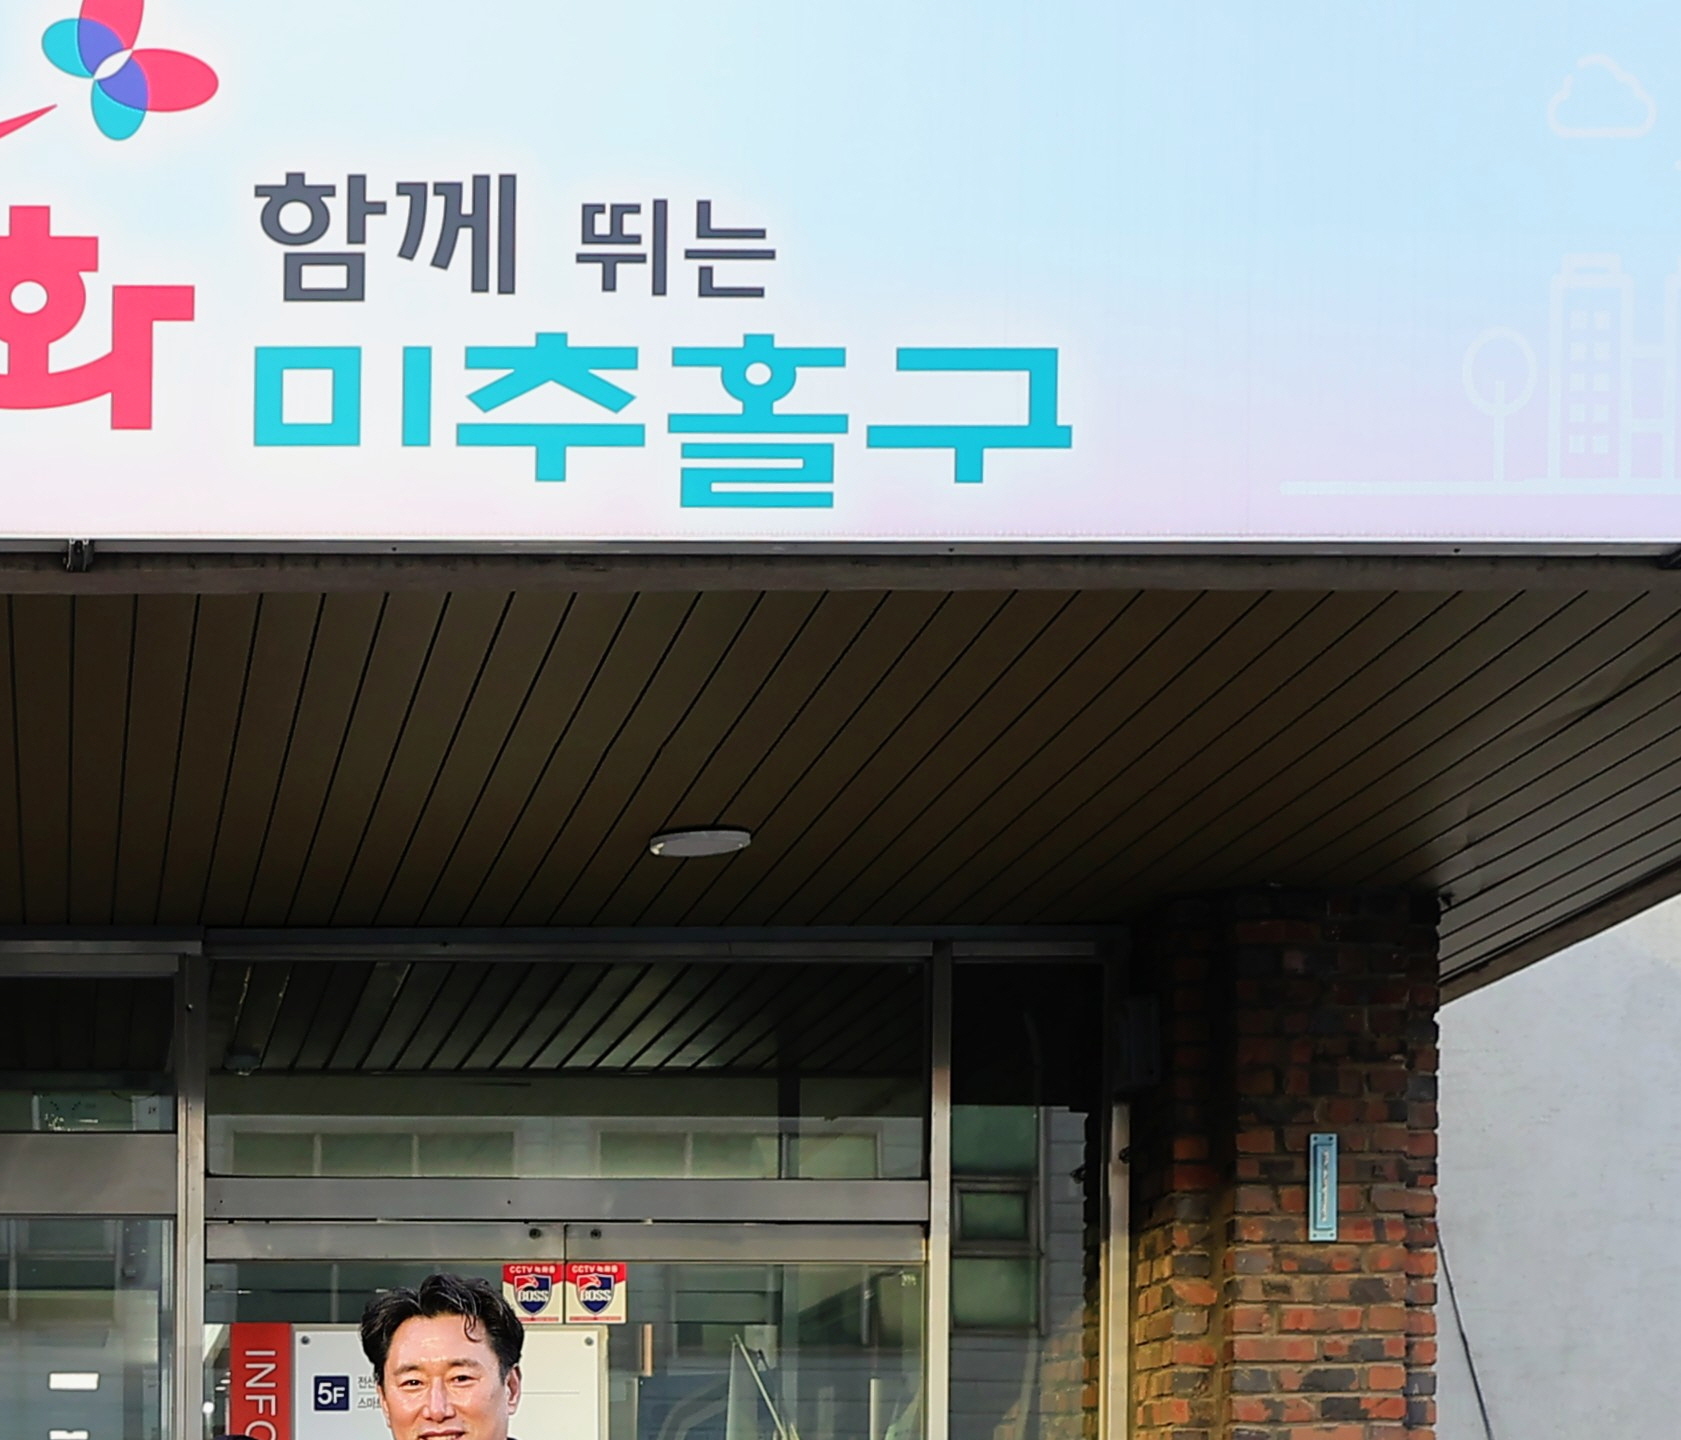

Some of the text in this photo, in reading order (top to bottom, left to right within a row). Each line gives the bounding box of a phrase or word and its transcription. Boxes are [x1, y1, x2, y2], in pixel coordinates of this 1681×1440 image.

[254, 172, 776, 301] 함께 뛰는
[254, 331, 1073, 508] 미추홀구
[571, 1265, 595, 1273] CCTV
[518, 1290, 548, 1301] BOSS
[580, 1289, 611, 1301] BOSS
[317, 1382, 345, 1405] 5F
